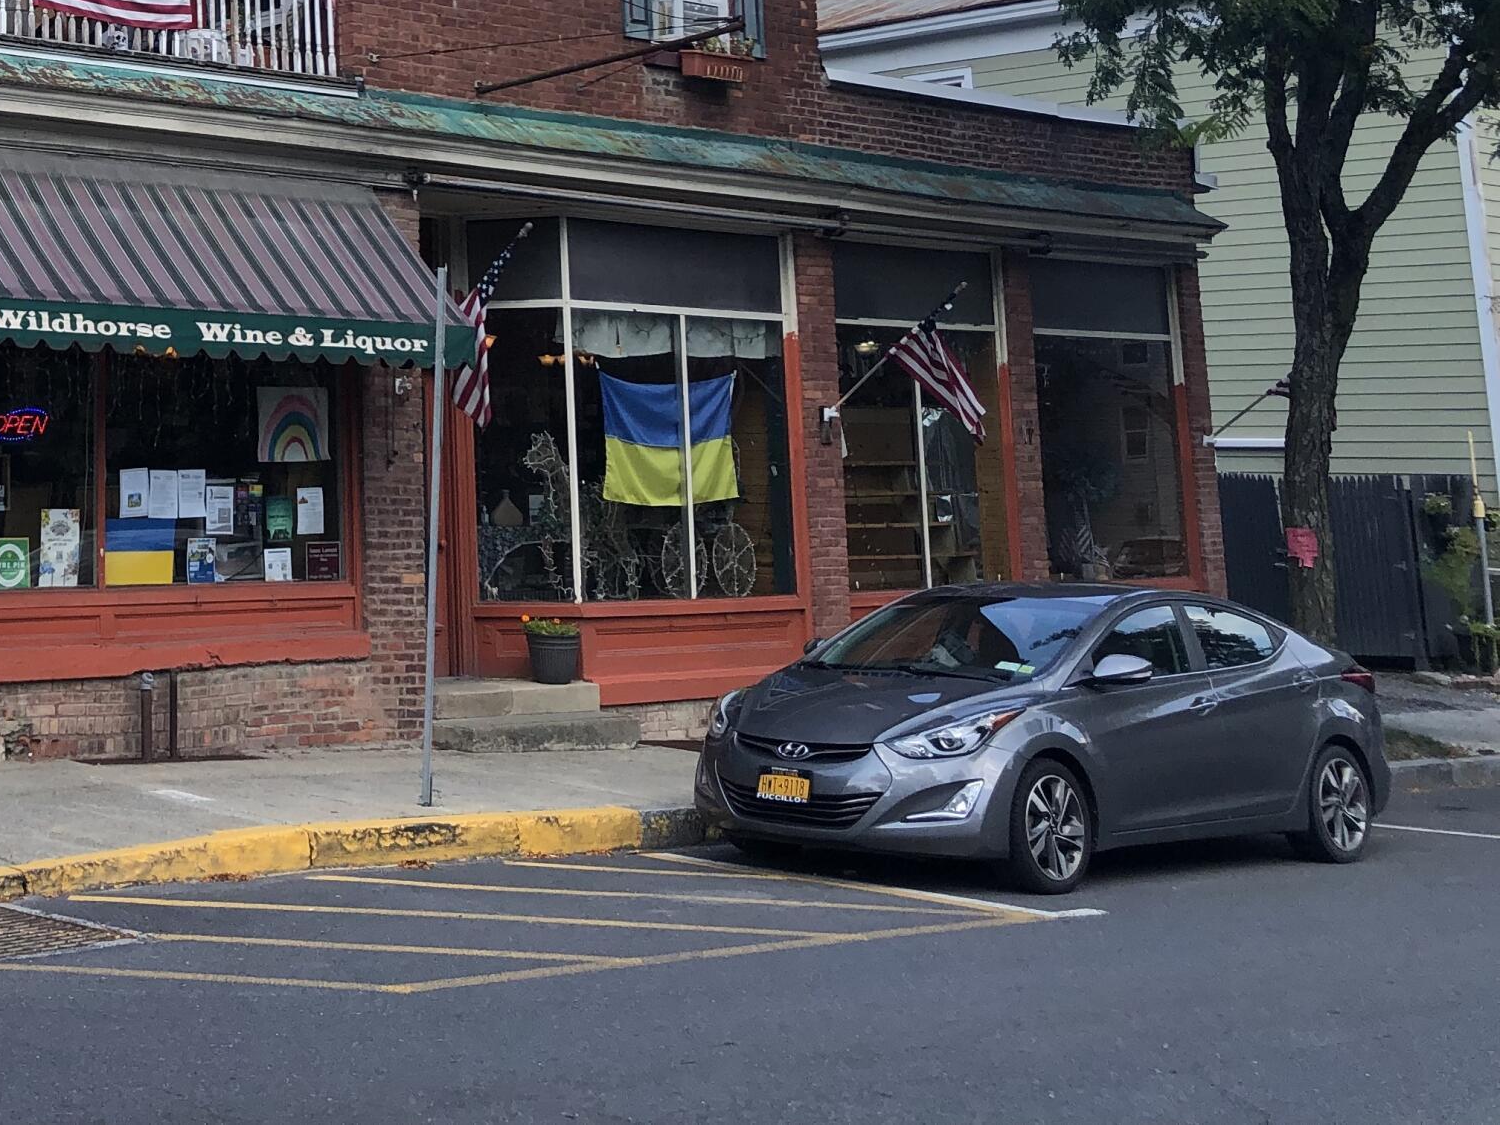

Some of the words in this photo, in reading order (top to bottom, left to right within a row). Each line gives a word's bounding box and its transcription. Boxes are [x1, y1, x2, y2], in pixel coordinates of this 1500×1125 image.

[195, 321, 283, 345] Wine
[287, 327, 315, 347] &
[320, 328, 429, 355] Liquor
[756, 792, 801, 803] FUCCILLO
